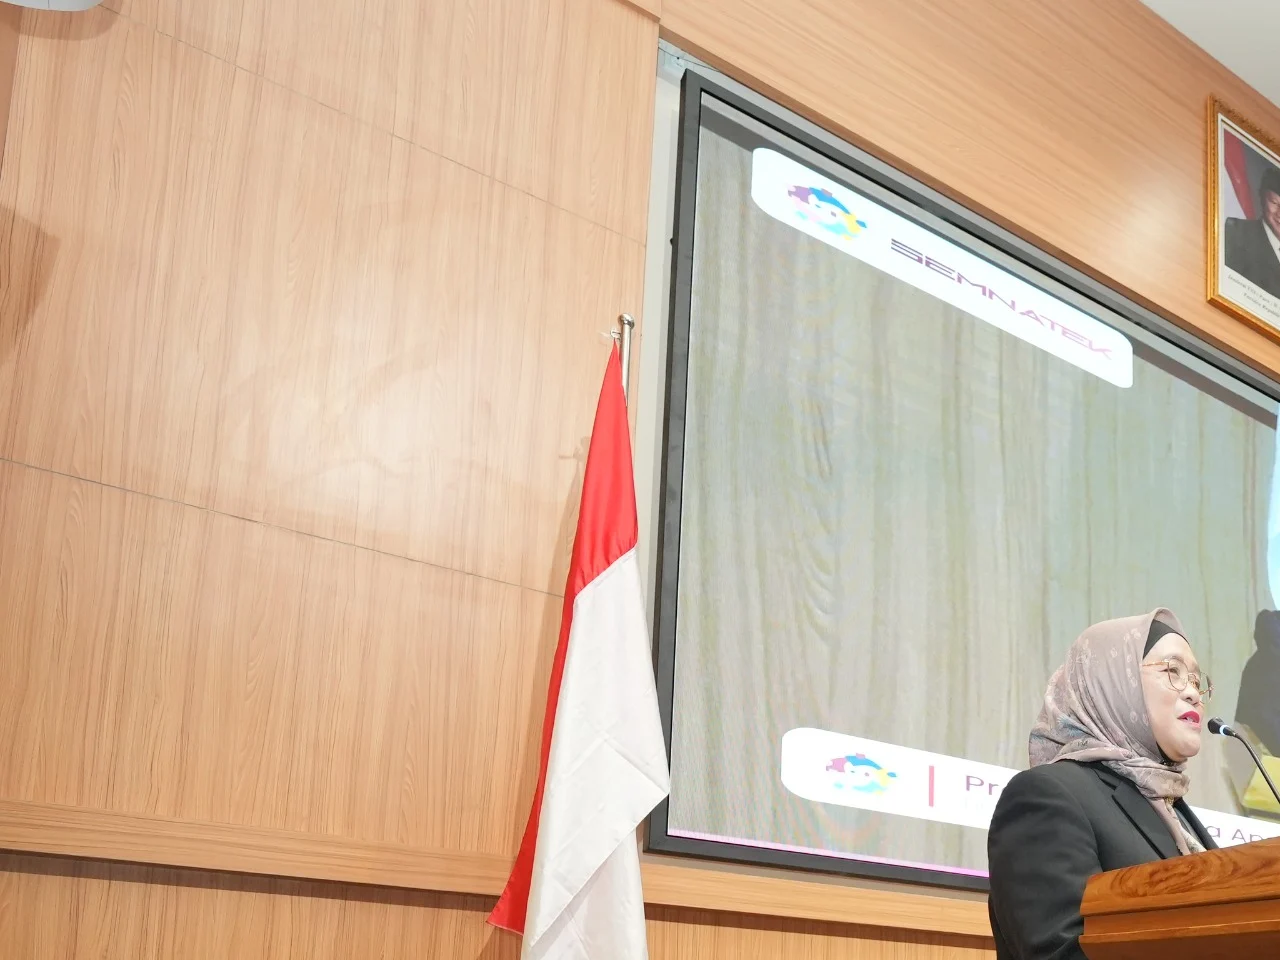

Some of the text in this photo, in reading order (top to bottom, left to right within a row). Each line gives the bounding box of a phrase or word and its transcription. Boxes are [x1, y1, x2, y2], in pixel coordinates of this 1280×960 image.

[891, 238, 1112, 360] SEMNATEK
[966, 775, 1000, 795] Pr
[1231, 828, 1264, 842] Ap
